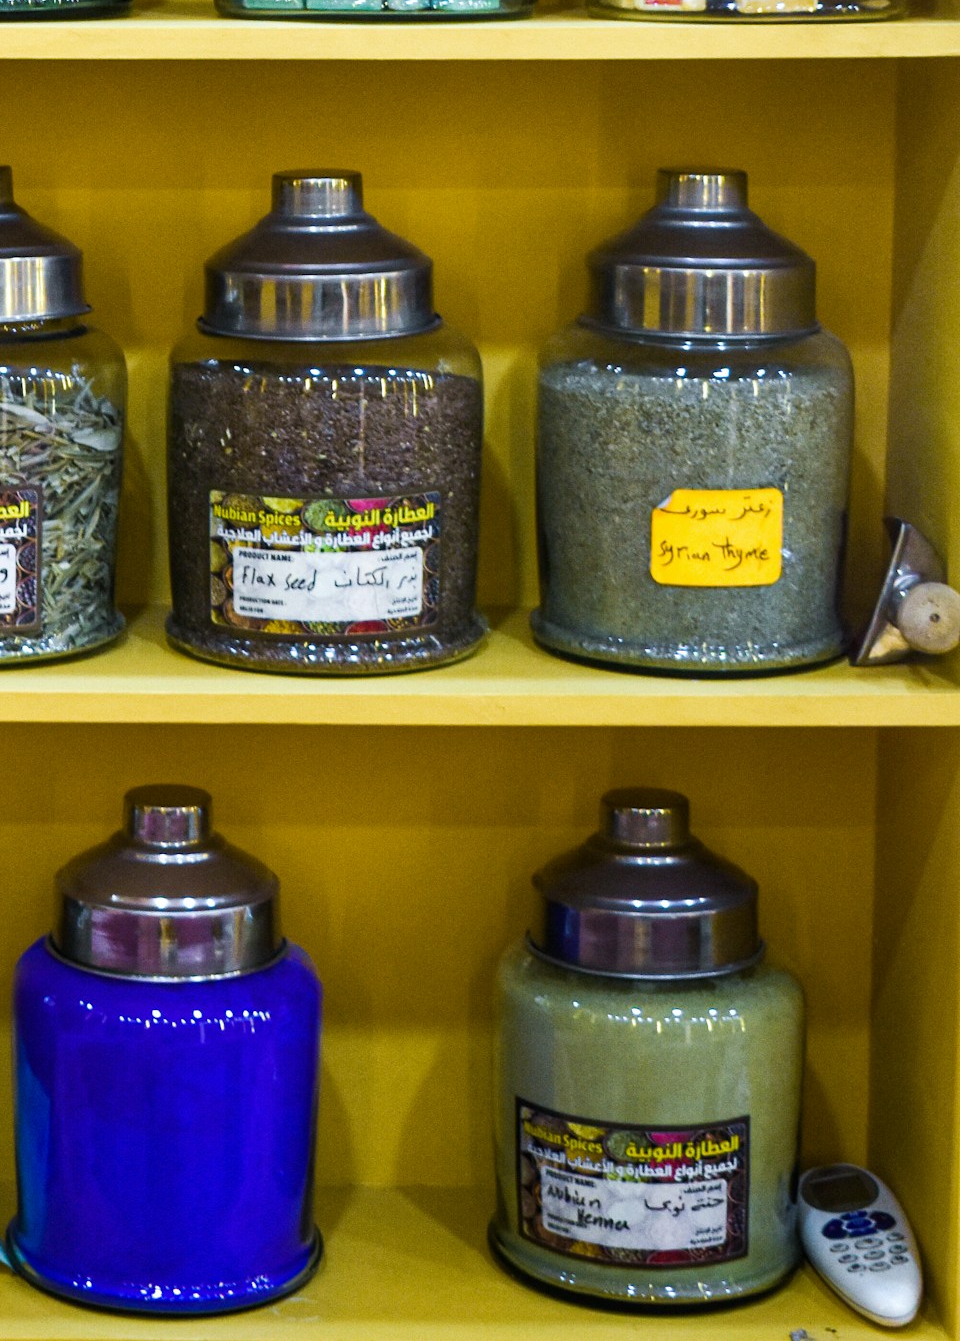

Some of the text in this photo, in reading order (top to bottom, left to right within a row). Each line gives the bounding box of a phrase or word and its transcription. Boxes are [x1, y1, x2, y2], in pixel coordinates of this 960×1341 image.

[213, 507, 301, 528] Nubian Spices
[325, 503, 434, 529] العطارة النوبية
[242, 566, 276, 587] Flax
[564, 1135, 603, 1154] Spices
[626, 1136, 739, 1161] العطارة النوبية
